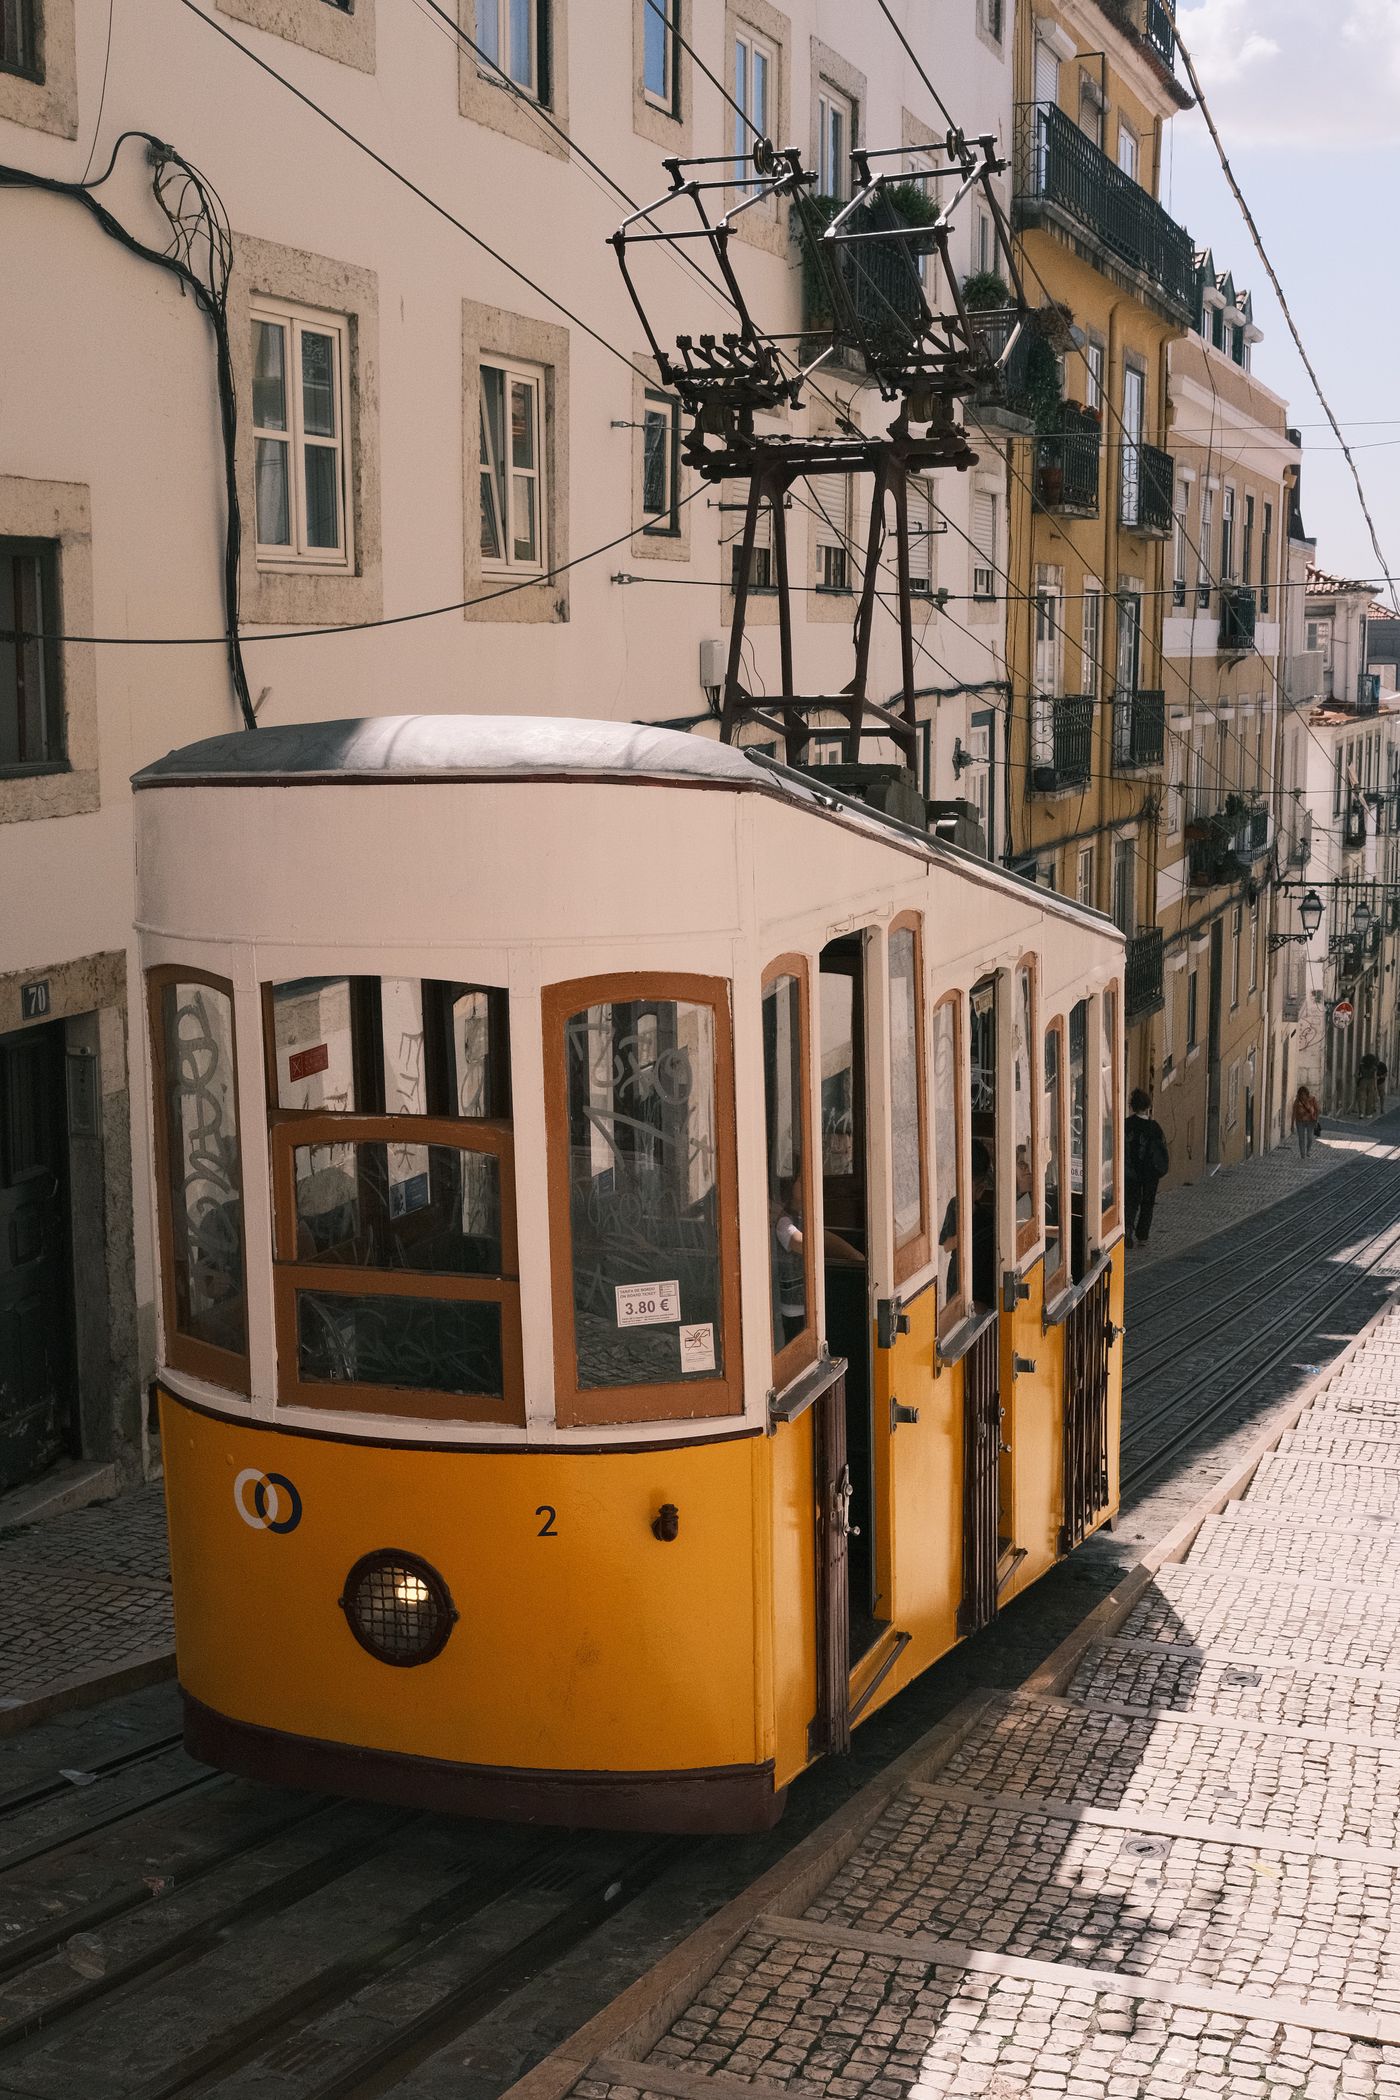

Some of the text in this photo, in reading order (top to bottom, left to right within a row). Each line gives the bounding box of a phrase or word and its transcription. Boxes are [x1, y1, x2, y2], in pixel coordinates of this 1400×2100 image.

[28, 985, 46, 1015] 70
[625, 1299, 669, 1315] 3.80 €
[535, 1505, 558, 1537] 2
